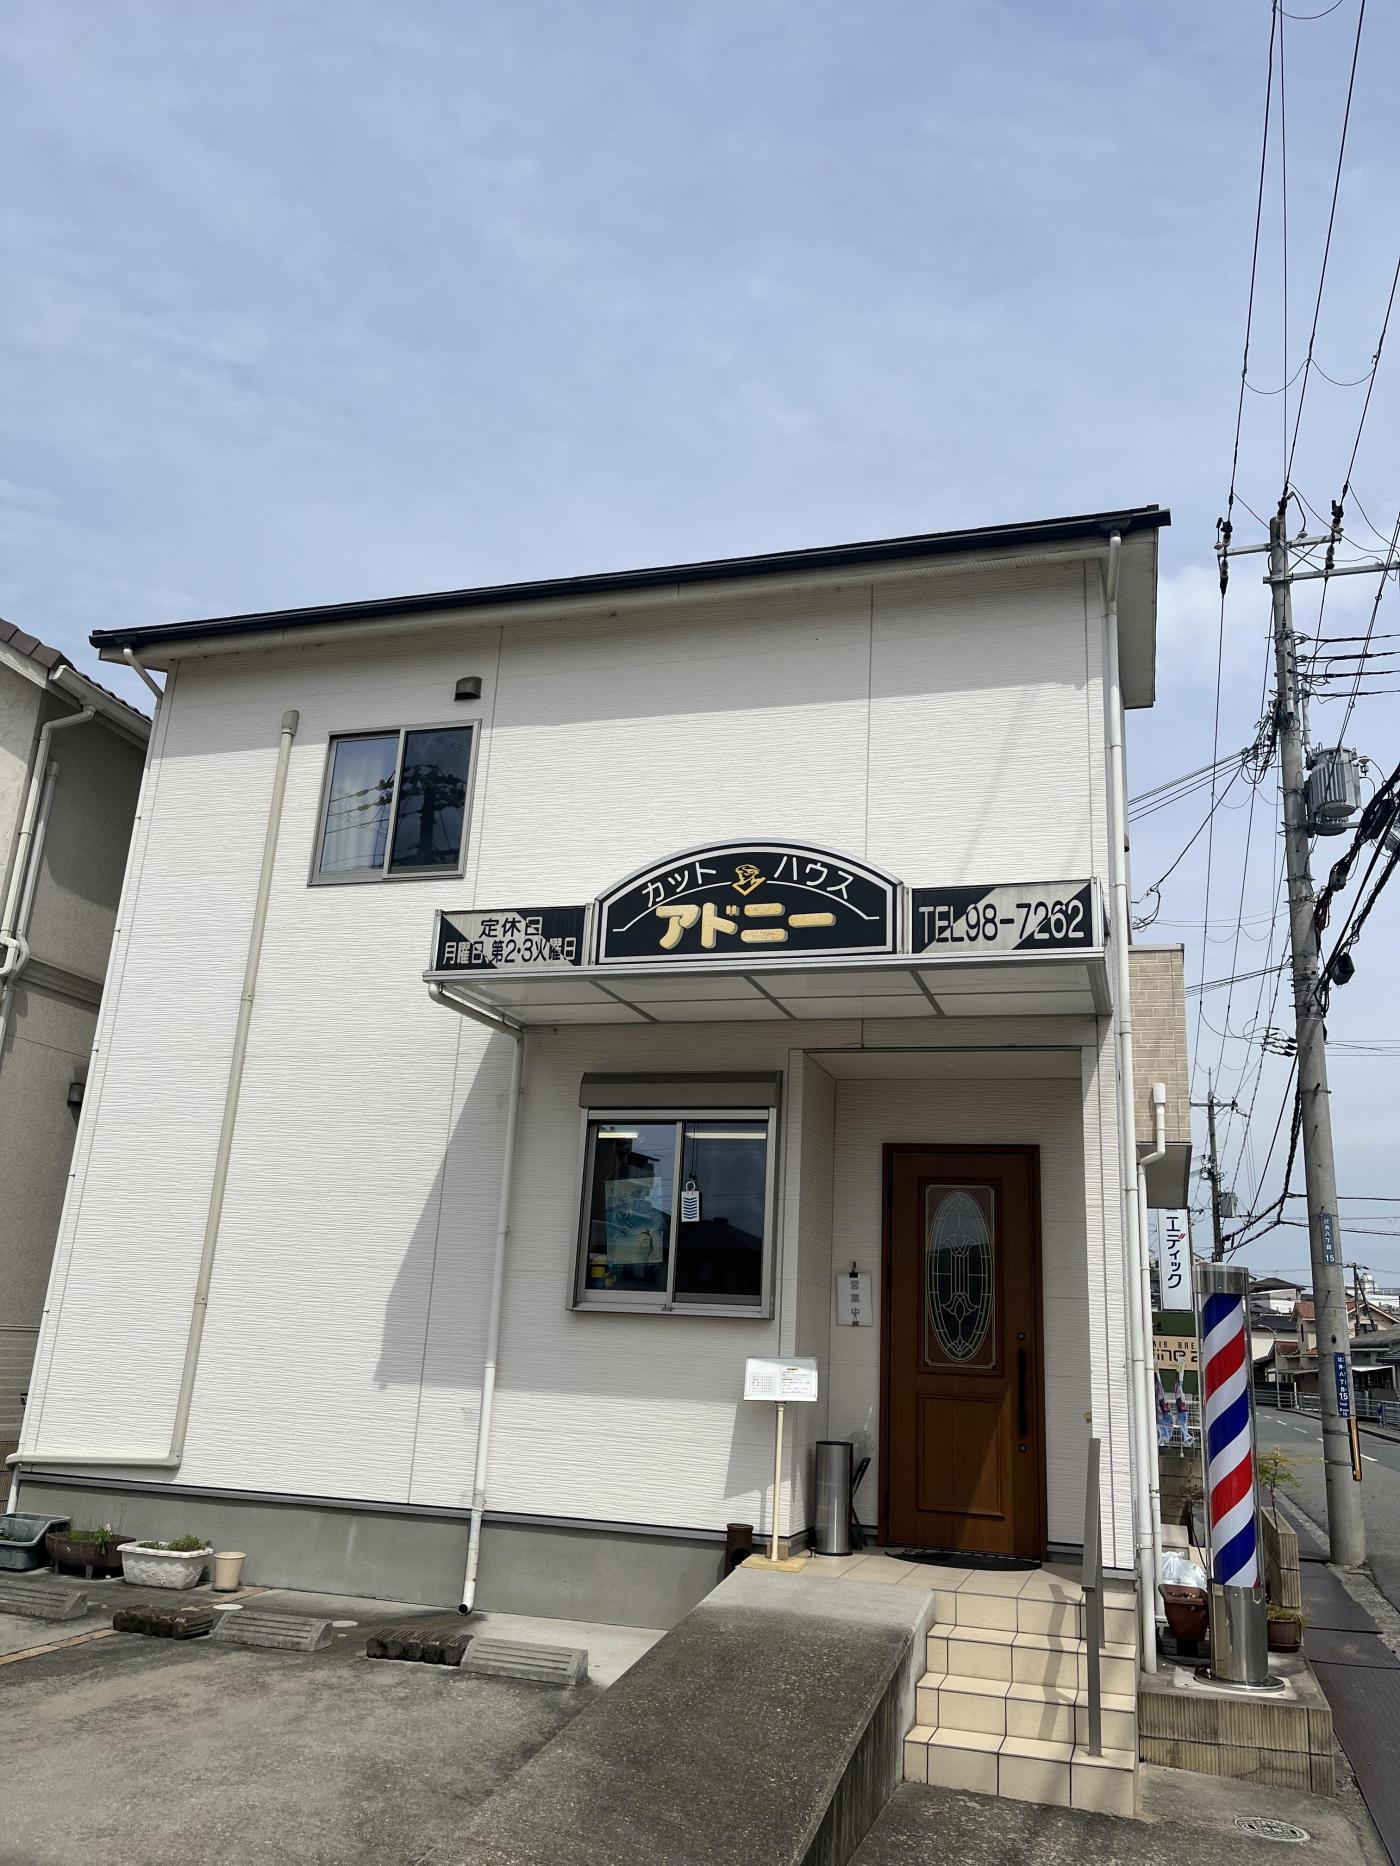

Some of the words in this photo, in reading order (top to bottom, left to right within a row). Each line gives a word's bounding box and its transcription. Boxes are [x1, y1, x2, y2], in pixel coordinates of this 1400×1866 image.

[641, 861, 717, 908] カット
[773, 855, 854, 900] ハウス
[479, 916, 543, 939] 定休日
[655, 902, 837, 950] アドニー
[1166, 1216, 1186, 1289] エディック
[1325, 1254, 1335, 1262] 15
